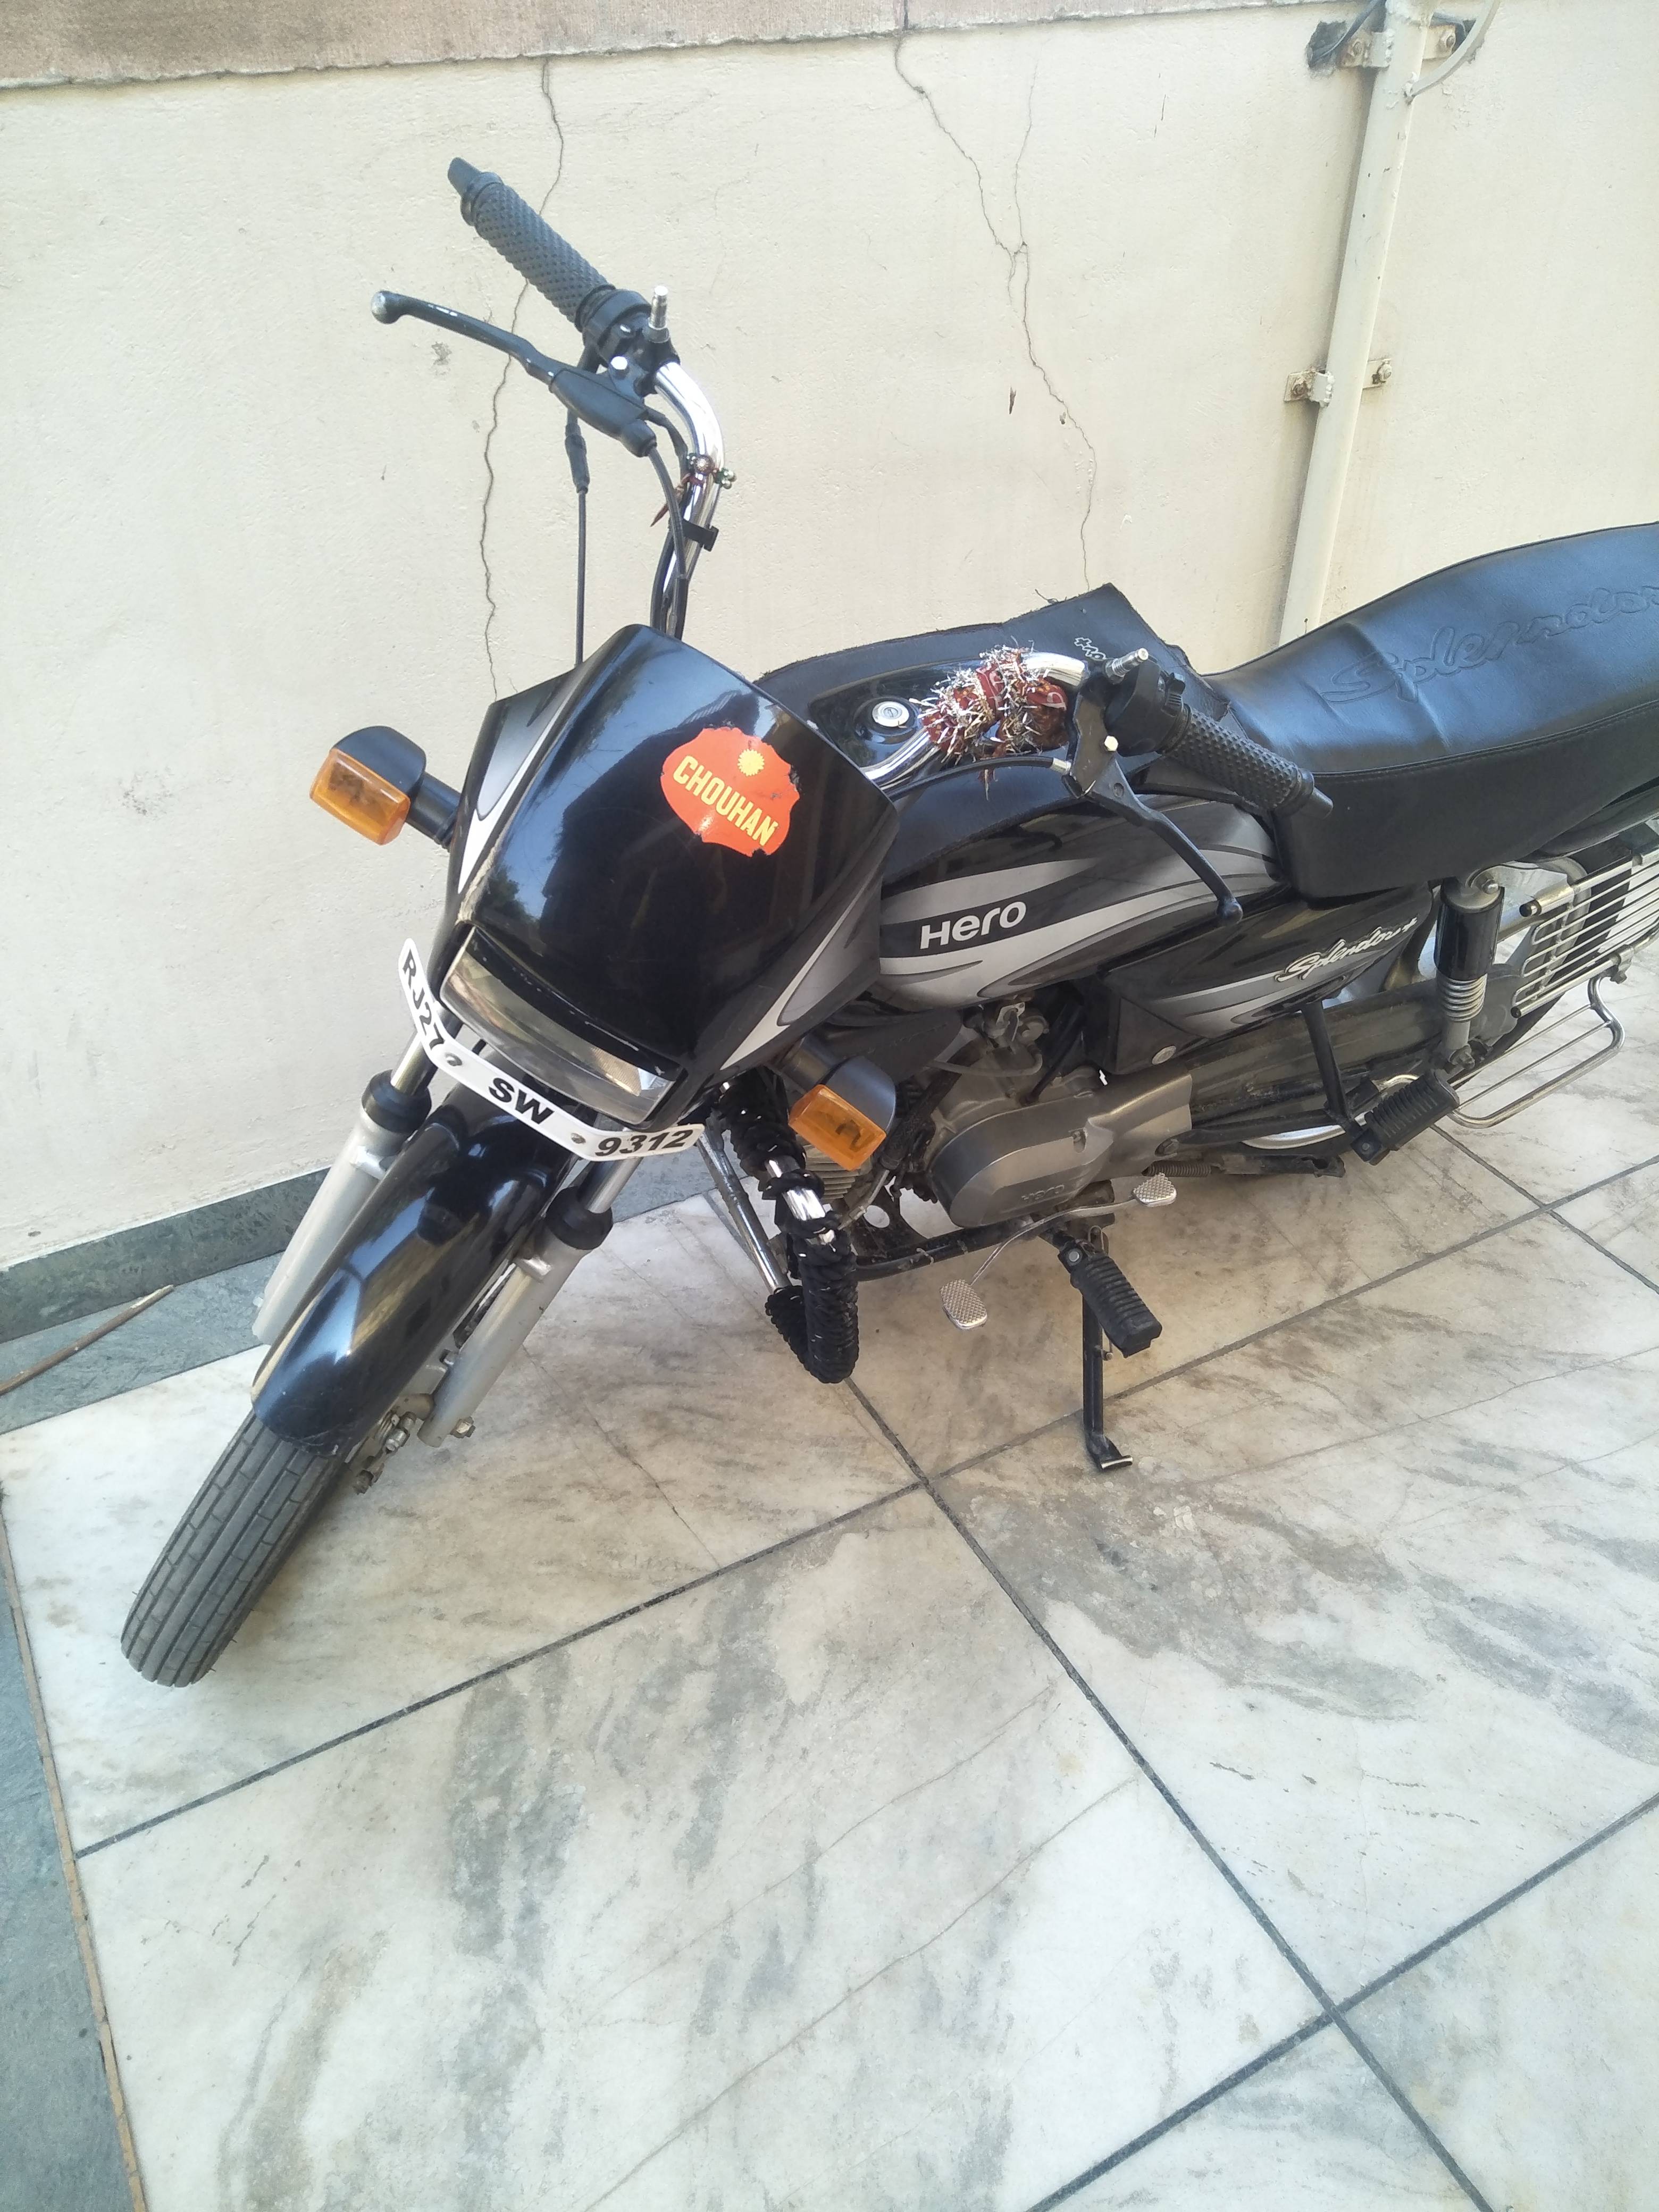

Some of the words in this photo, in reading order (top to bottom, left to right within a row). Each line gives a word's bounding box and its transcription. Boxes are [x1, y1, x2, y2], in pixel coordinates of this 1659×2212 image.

[673, 755, 780, 847] CHOUHAN
[920, 901, 1027, 950] Hero
[403, 948, 446, 1051] RJ27
[488, 1077, 555, 1125] SW
[595, 1129, 693, 1157] 9312
